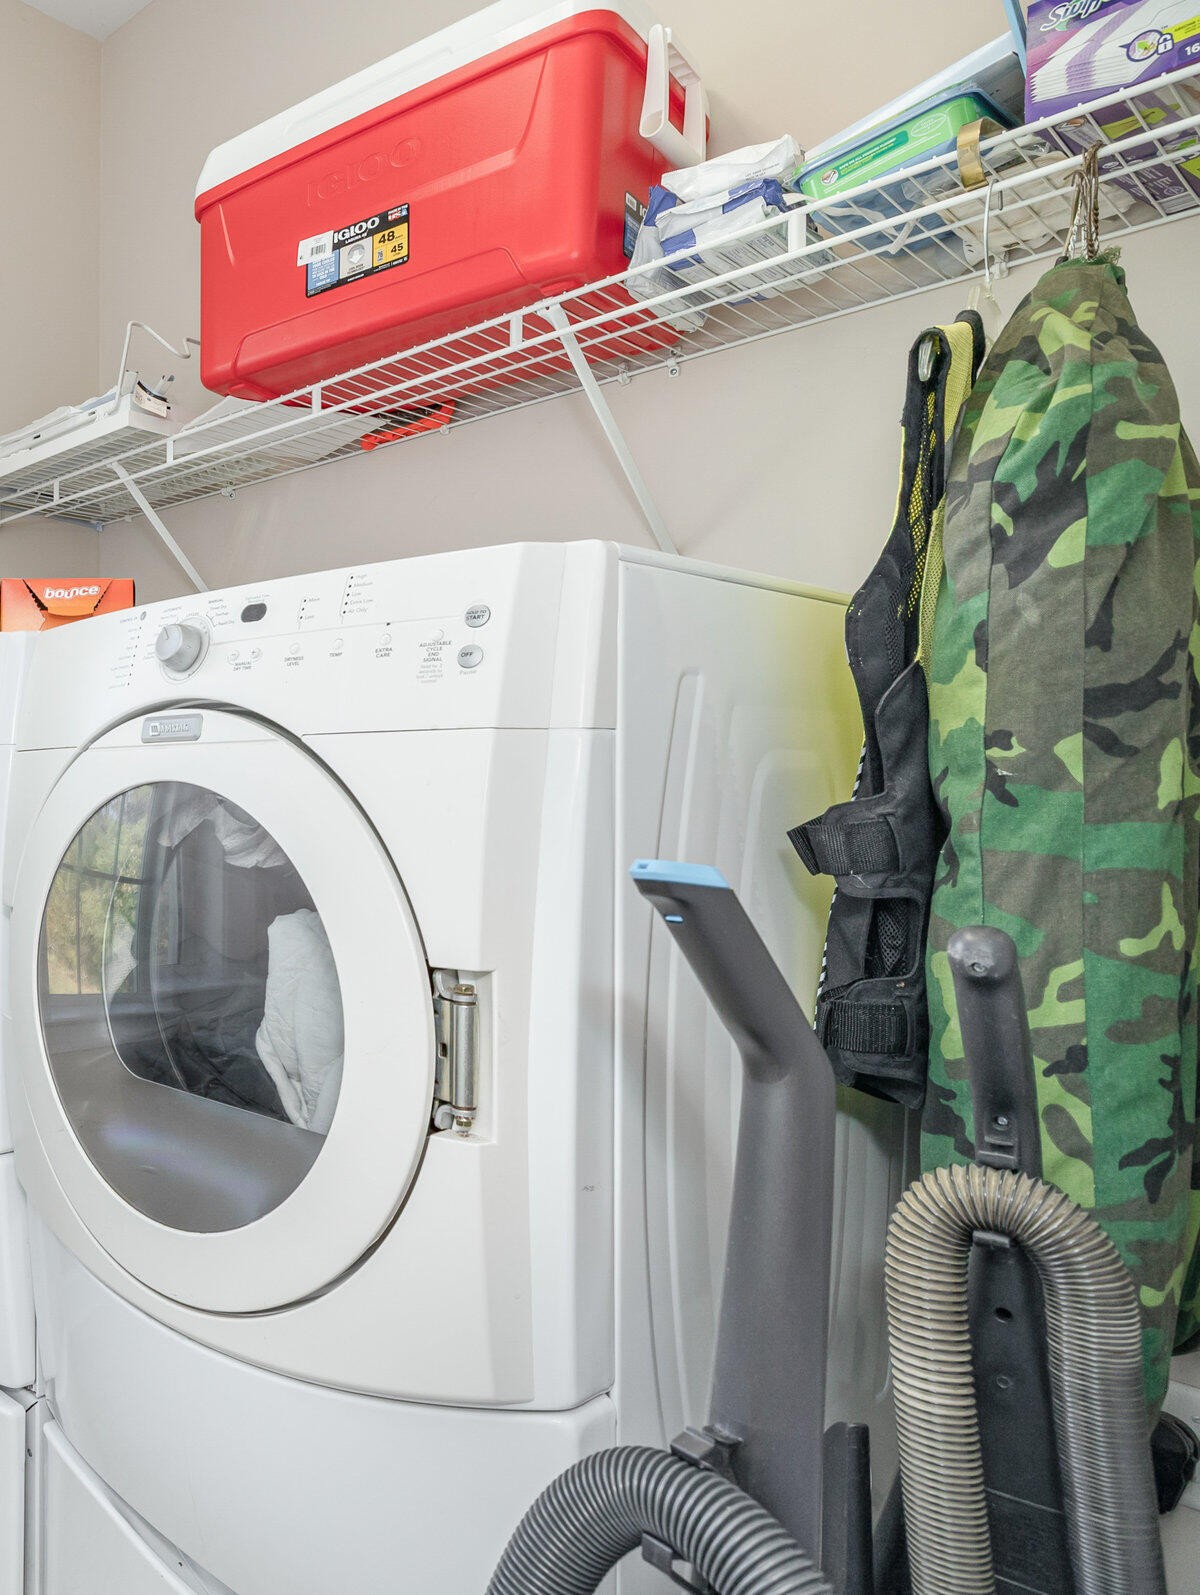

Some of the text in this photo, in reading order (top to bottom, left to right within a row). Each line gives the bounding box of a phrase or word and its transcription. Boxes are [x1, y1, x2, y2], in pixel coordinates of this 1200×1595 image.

[306, 137, 422, 206] IGLOO
[333, 217, 380, 244] IGLOO
[378, 230, 395, 244] 48
[391, 243, 403, 253] 45
[45, 585, 99, 599] bounce
[420, 640, 452, 648] ADJUSTABLE
